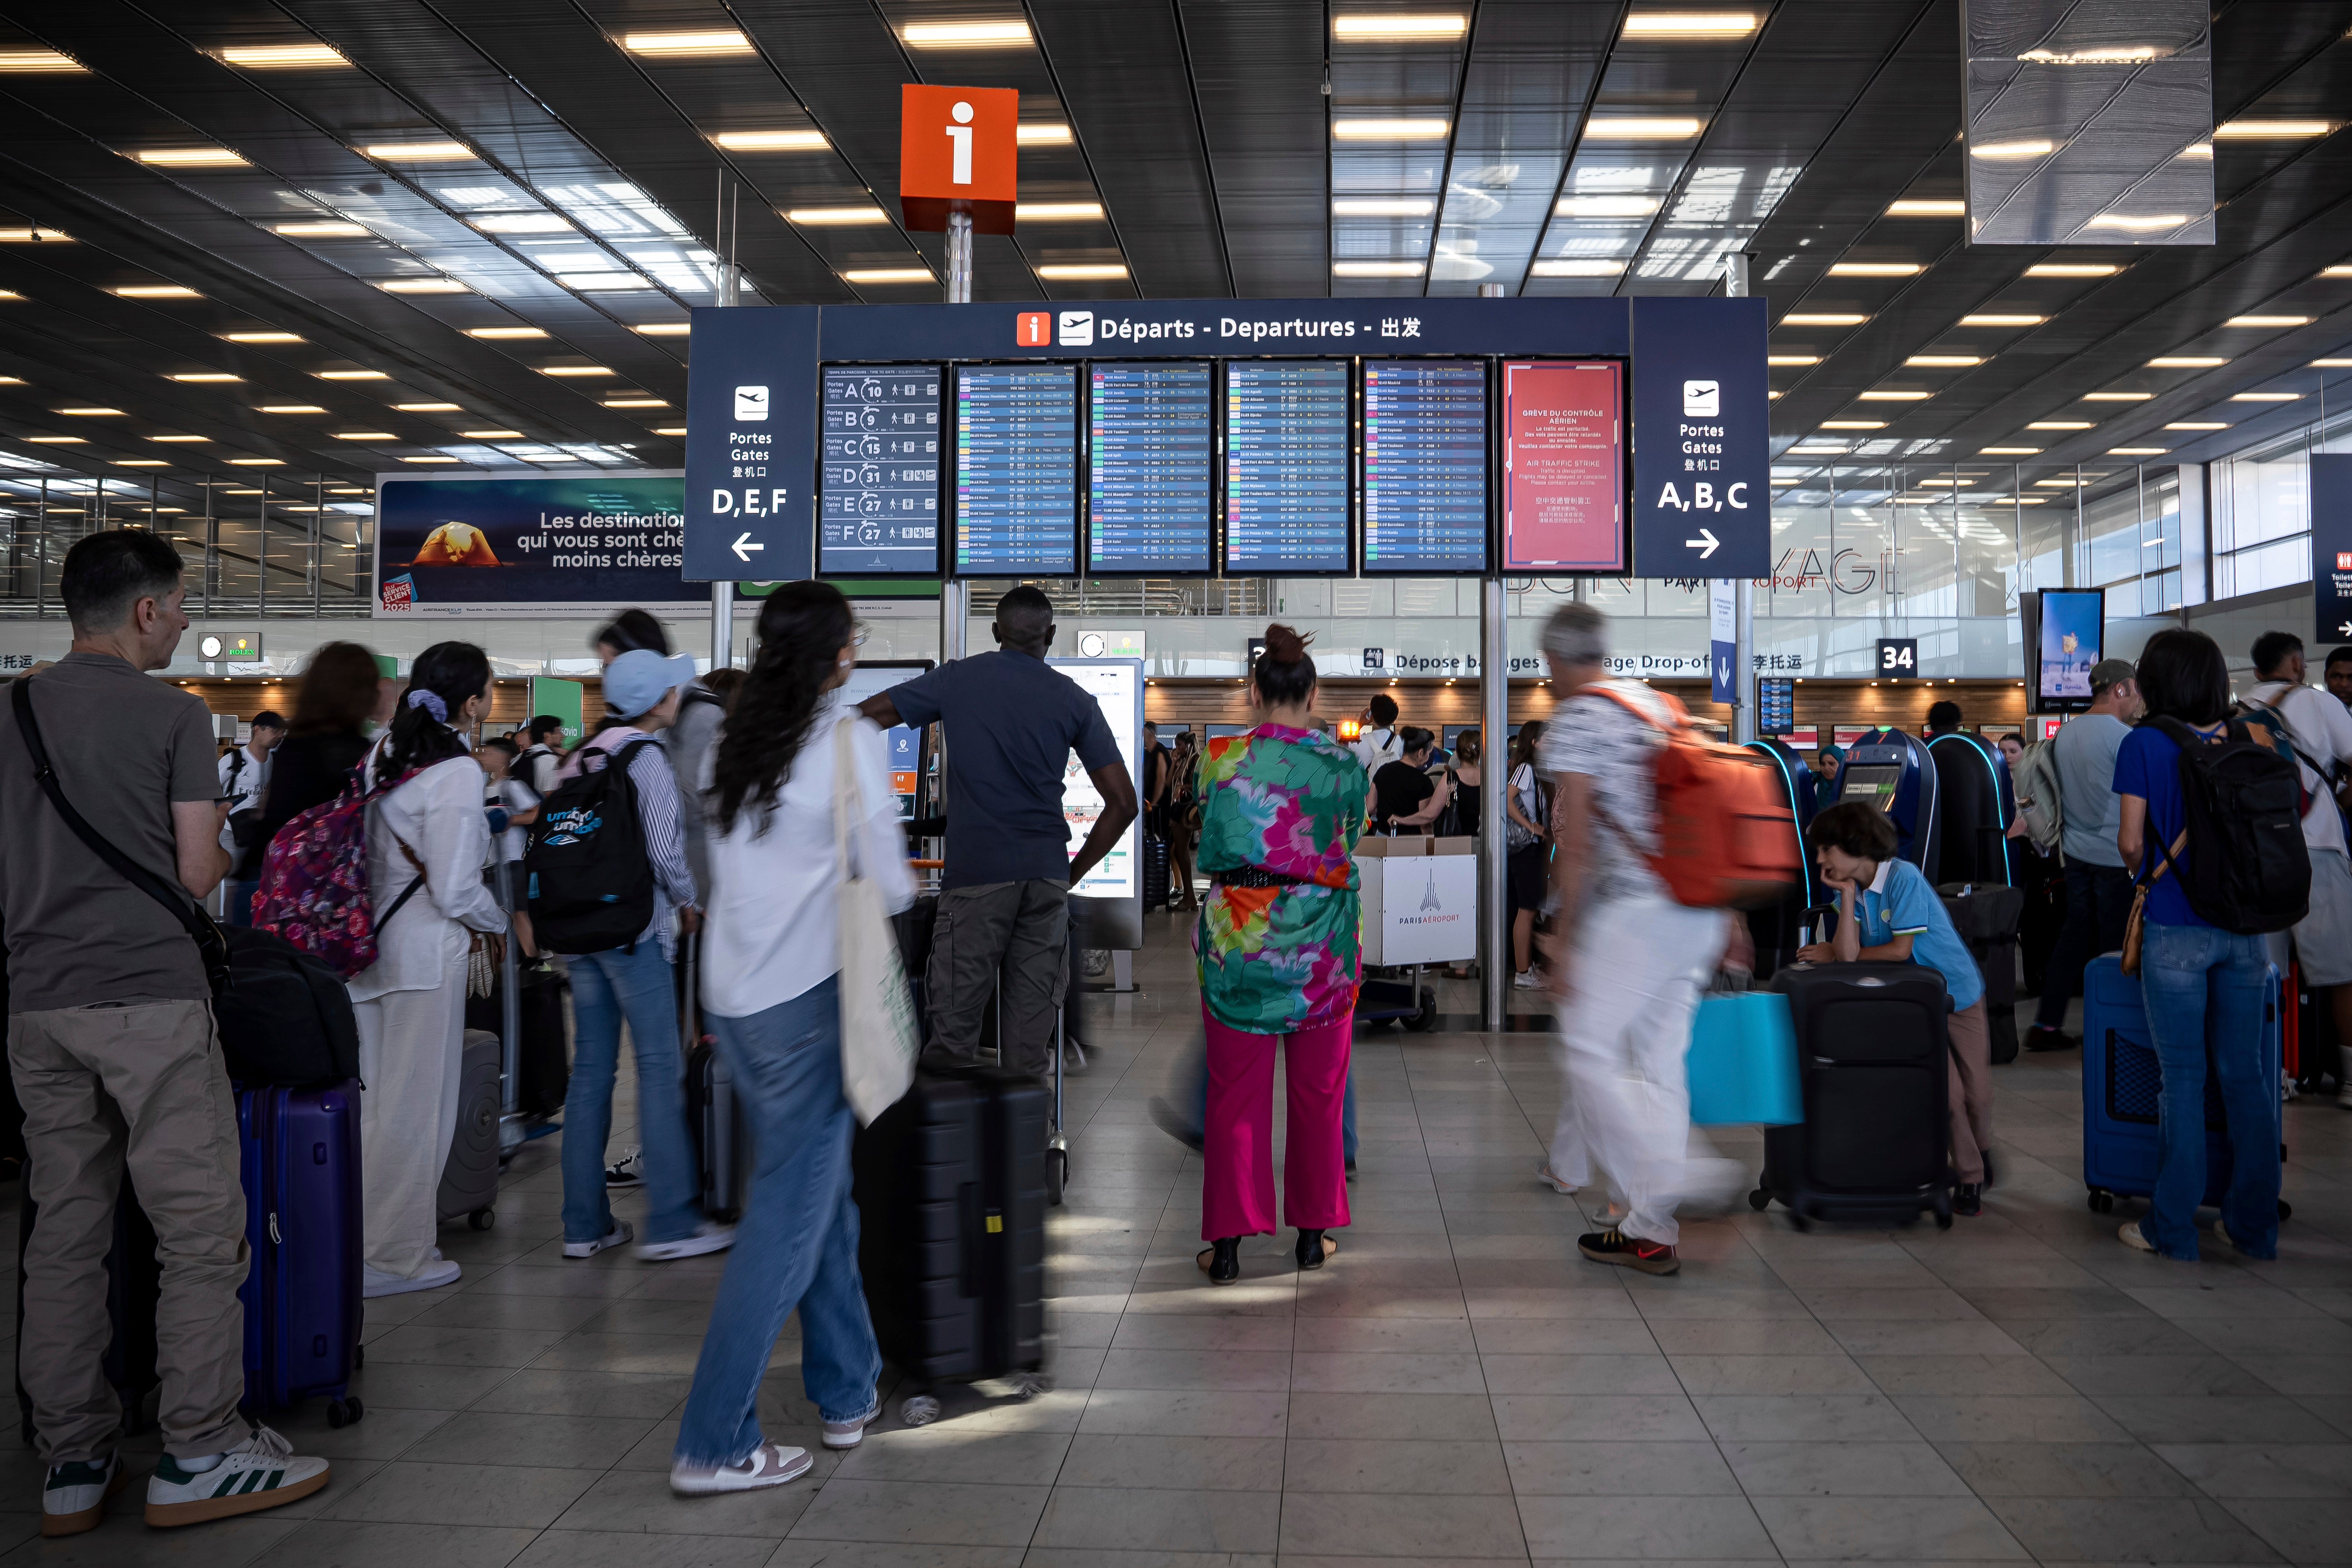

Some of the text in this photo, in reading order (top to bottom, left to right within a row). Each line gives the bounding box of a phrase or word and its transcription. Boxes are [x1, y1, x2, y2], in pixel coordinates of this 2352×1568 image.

[1101, 318, 1194, 343] Départs
[1221, 318, 1355, 342] Departures
[1381, 317, 1420, 338] 出发
[845, 383, 858, 398] A
[868, 387, 882, 397] 10
[846, 411, 857, 426] B
[1523, 408, 1548, 417] GRÈVE
[1563, 408, 1603, 417] CONTRÔLE
[867, 415, 875, 426] 9
[1680, 424, 1724, 437] Portes
[730, 432, 772, 444] Portes
[844, 440, 856, 455] C
[867, 443, 880, 454] 15
[1682, 441, 1722, 454] Gates
[732, 449, 769, 461] Gates
[1684, 458, 1719, 471] 登机口
[733, 466, 766, 478] 登机口
[843, 468, 856, 483] D
[866, 472, 880, 483] 31
[844, 497, 855, 512] E
[866, 501, 881, 512] 27
[541, 511, 683, 528] Les destinatio
[844, 526, 854, 540] F
[865, 529, 881, 540] 27
[518, 532, 547, 553] qui
[553, 535, 599, 548] vous
[604, 533, 648, 547] sont
[553, 551, 682, 567] moins chères
[384, 583, 411, 597] SERVICE
[385, 589, 411, 603] CLIENT
[0, 655, 32, 668] 托运
[1396, 655, 1460, 672] Dépose
[1642, 654, 1712, 672] Drop-of
[1753, 654, 1802, 669] 李托运
[1883, 647, 1913, 669] 34
[1877, 732, 1888, 745] 7
[1845, 750, 1861, 762] 31
[547, 807, 594, 822] umbro
